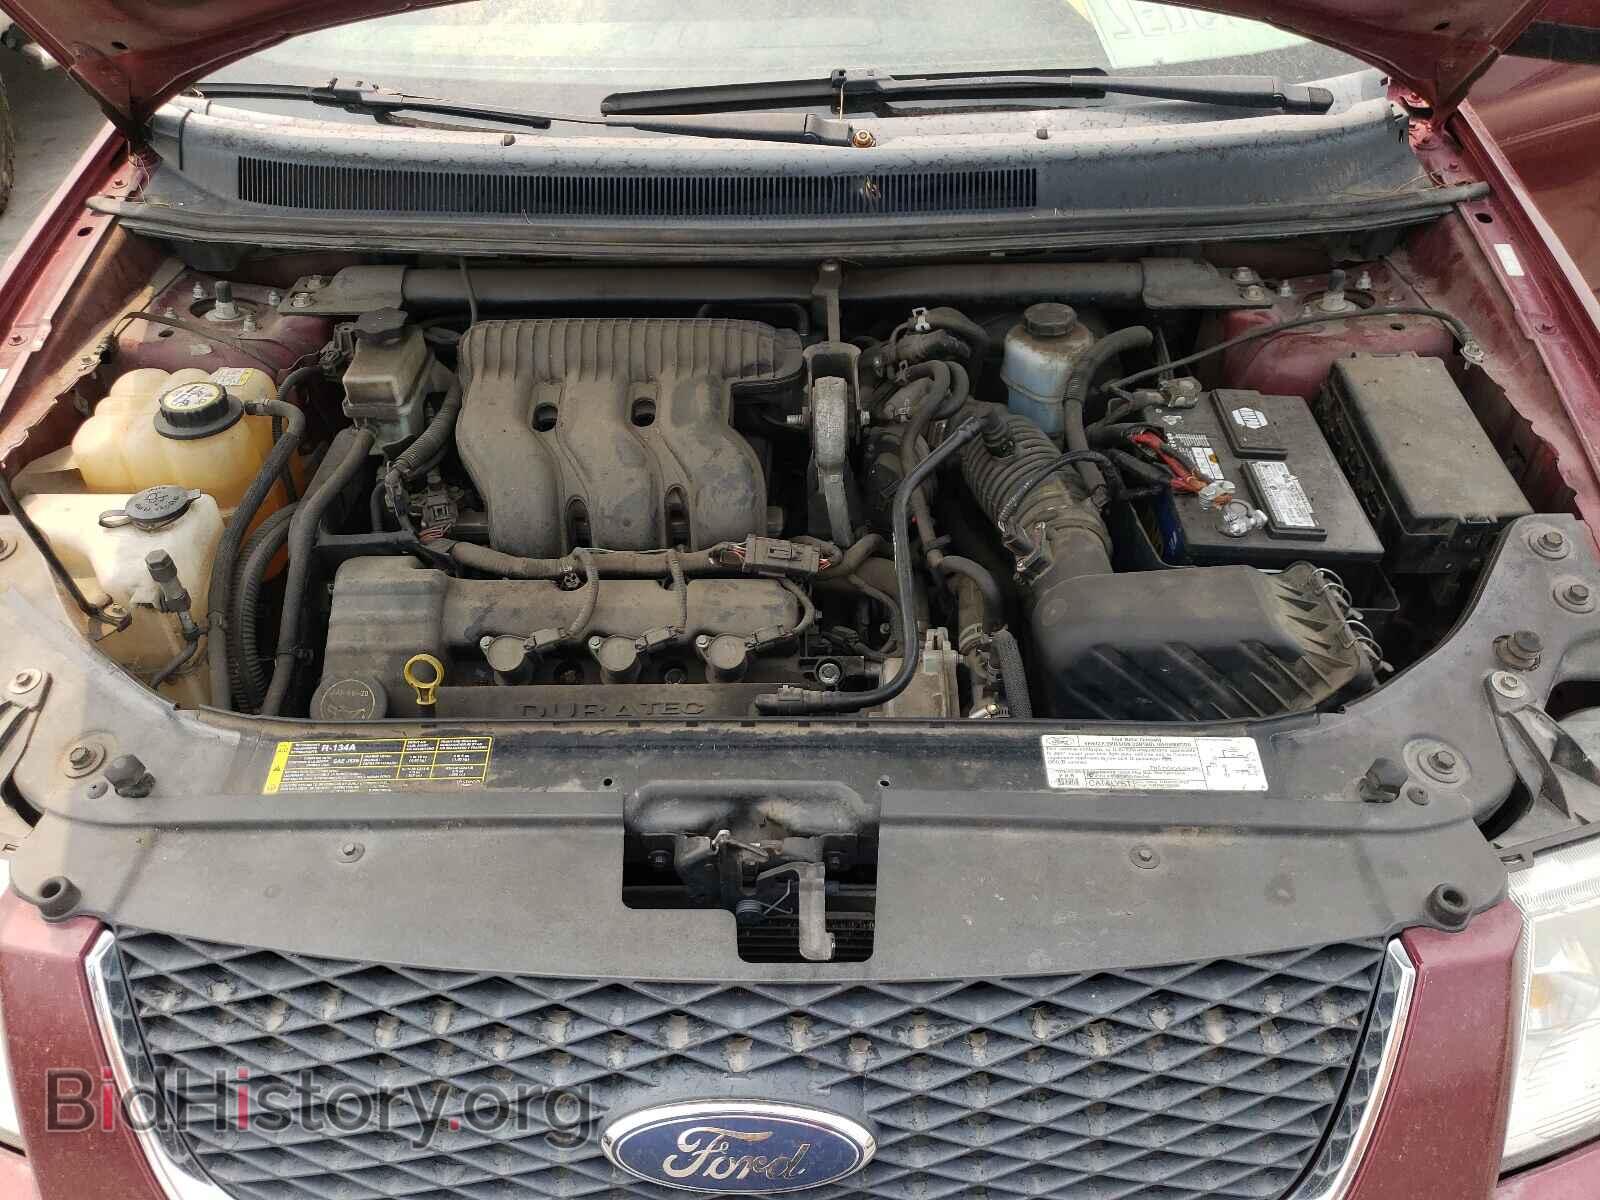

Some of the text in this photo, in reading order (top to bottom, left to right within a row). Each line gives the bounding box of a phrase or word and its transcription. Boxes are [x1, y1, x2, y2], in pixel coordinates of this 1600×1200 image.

[520, 703, 704, 717] DURATEC
[320, 744, 356, 752] R-134A
[661, 1126, 812, 1180] Ford
